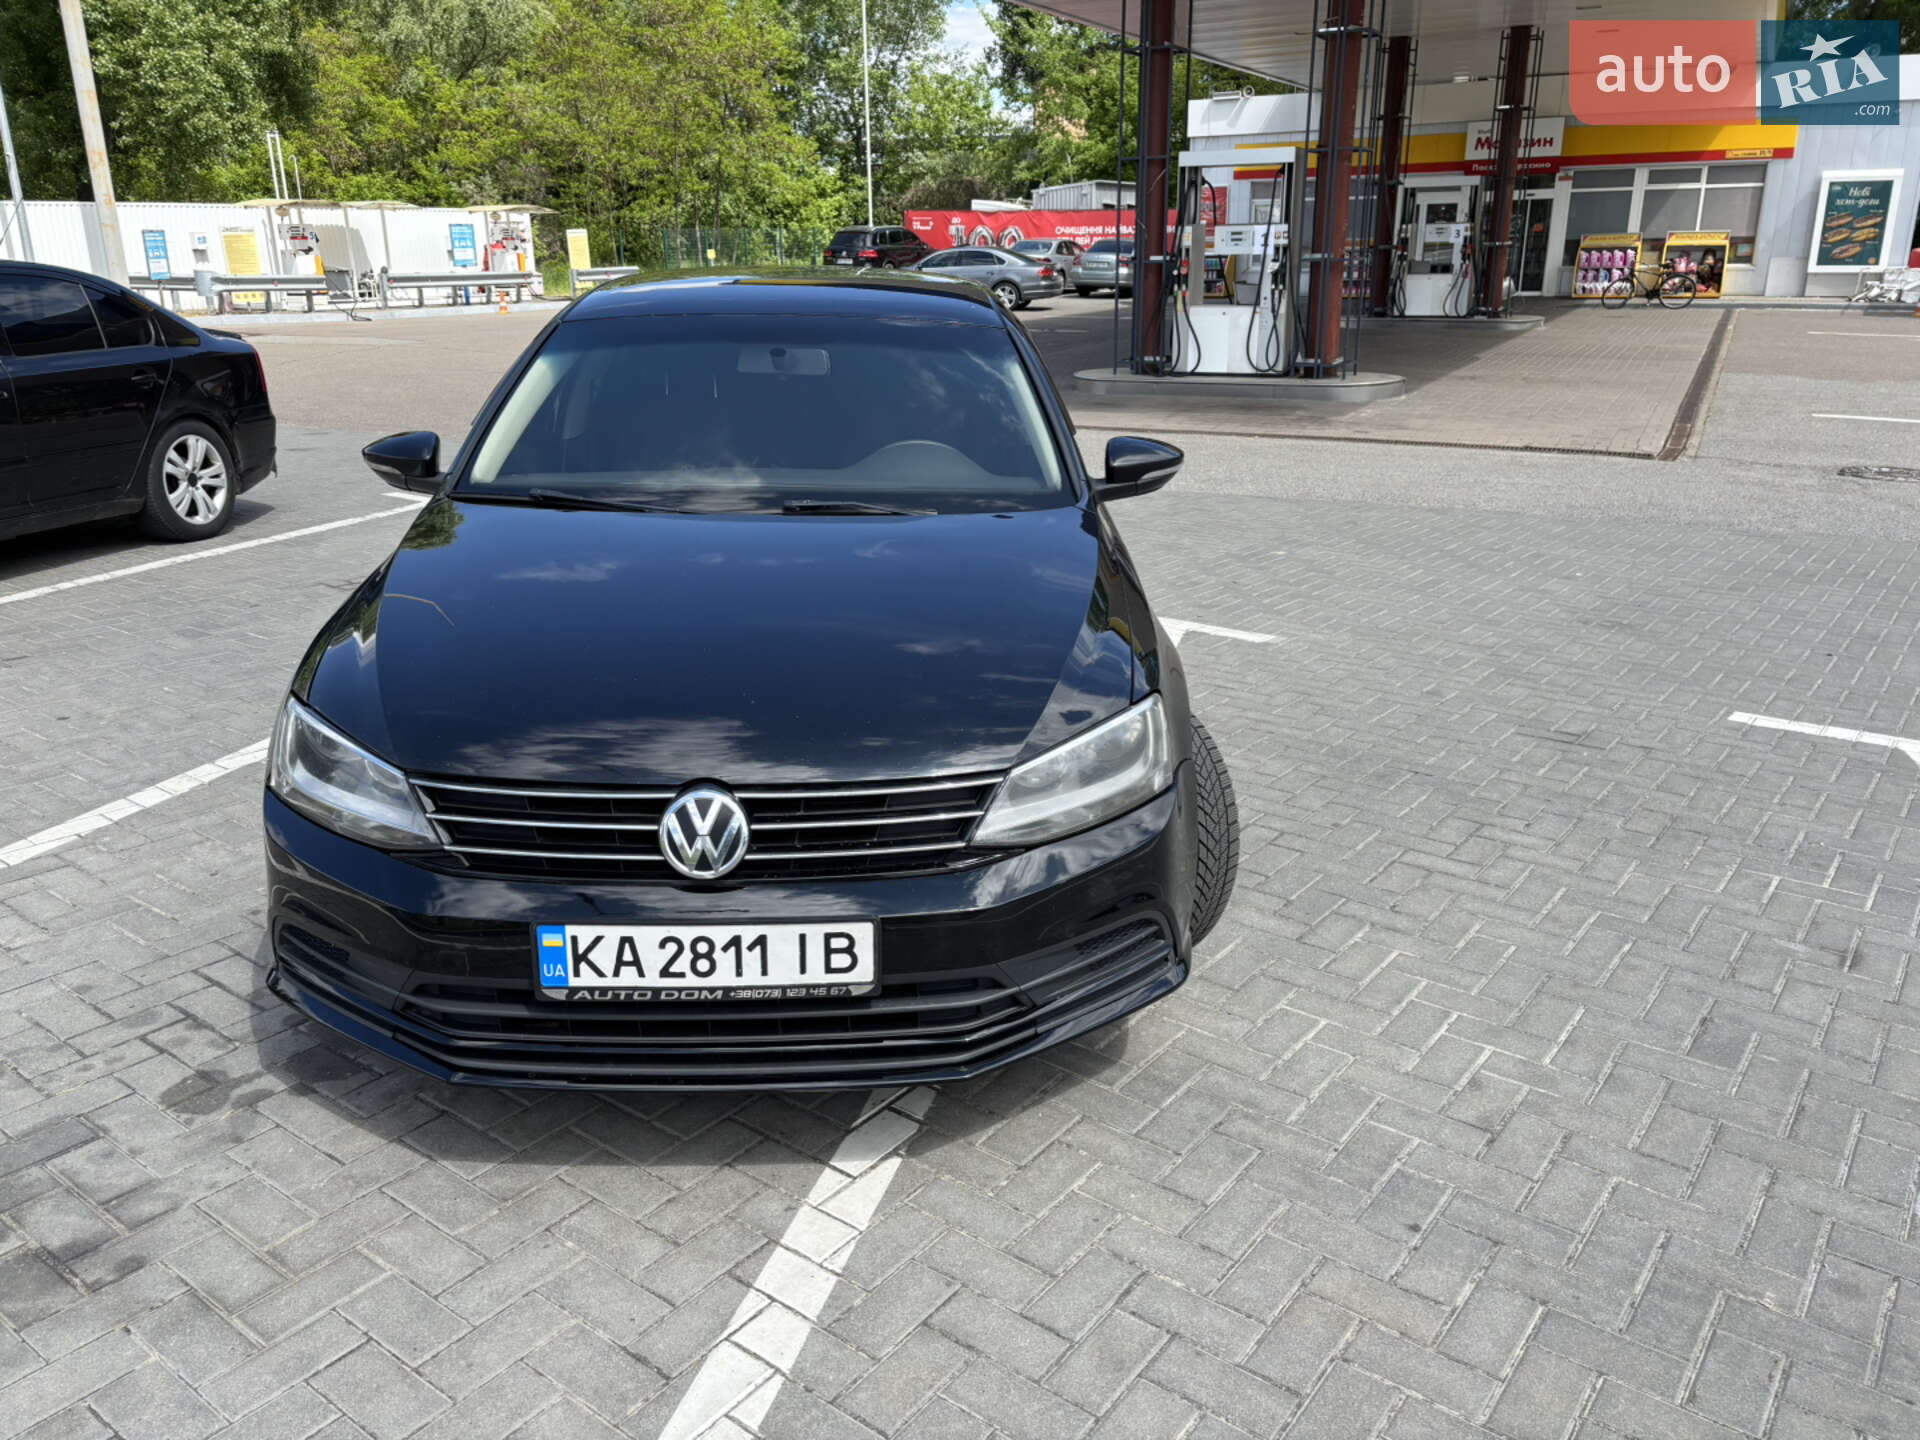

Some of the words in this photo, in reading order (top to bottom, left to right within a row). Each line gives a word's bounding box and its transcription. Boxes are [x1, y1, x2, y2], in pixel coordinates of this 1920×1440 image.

[570, 935, 647, 979] KA
[658, 934, 768, 979] 2811
[799, 931, 859, 975] IB
[543, 963, 565, 977] UA
[573, 990, 652, 1000] AUTO
[660, 989, 724, 1000] DOM
[730, 988, 782, 999] +38(073)
[786, 988, 807, 997] 123
[809, 987, 827, 996] 45
[830, 986, 848, 996] 67
